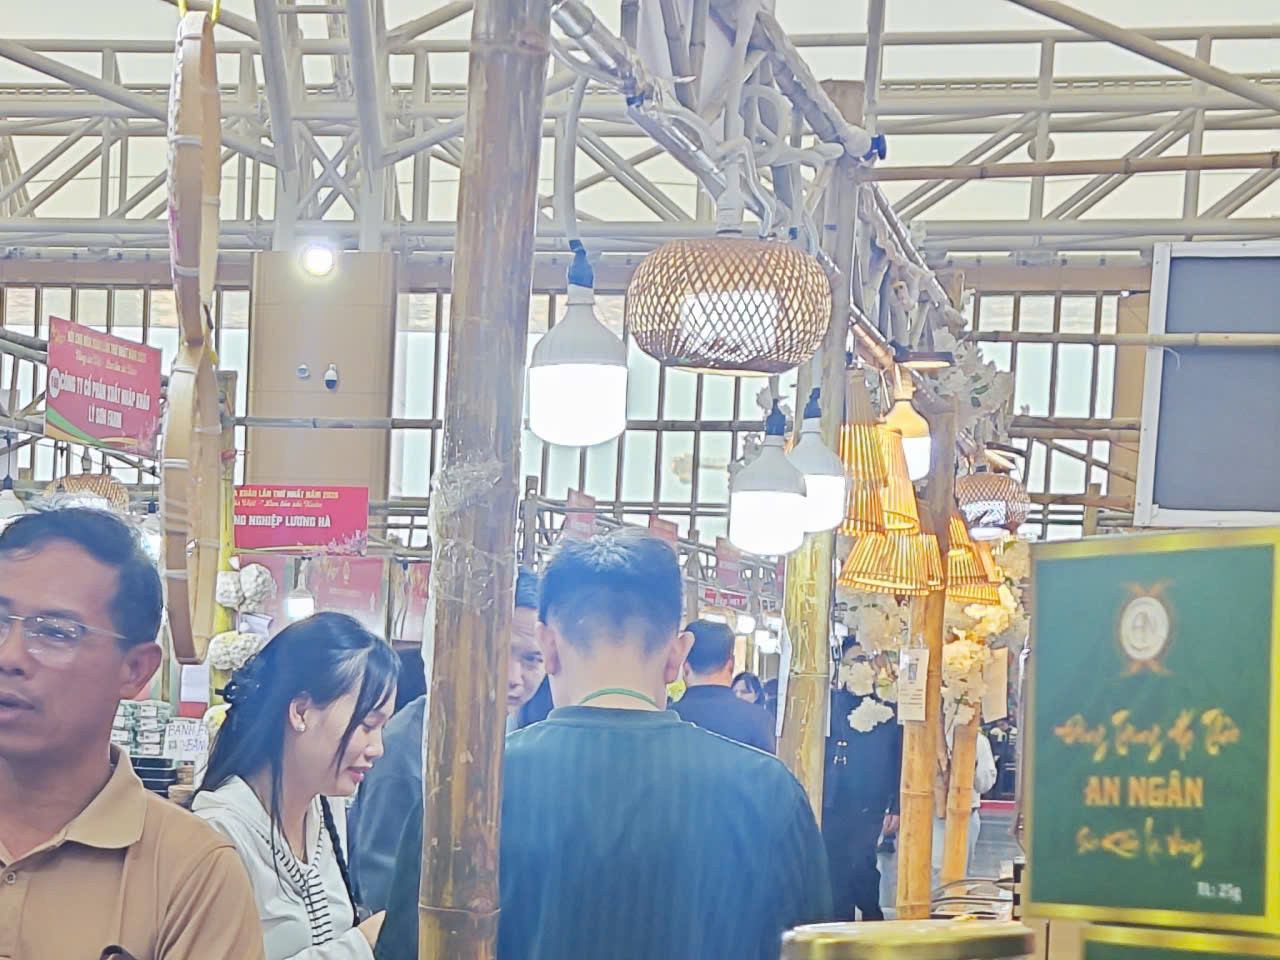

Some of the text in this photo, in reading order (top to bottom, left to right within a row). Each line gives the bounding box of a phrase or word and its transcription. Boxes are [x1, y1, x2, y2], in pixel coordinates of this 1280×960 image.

[248, 512, 283, 528] NGHIỆP
[318, 514, 331, 527] HÀ
[1084, 769, 1205, 809] AN NGÂN
